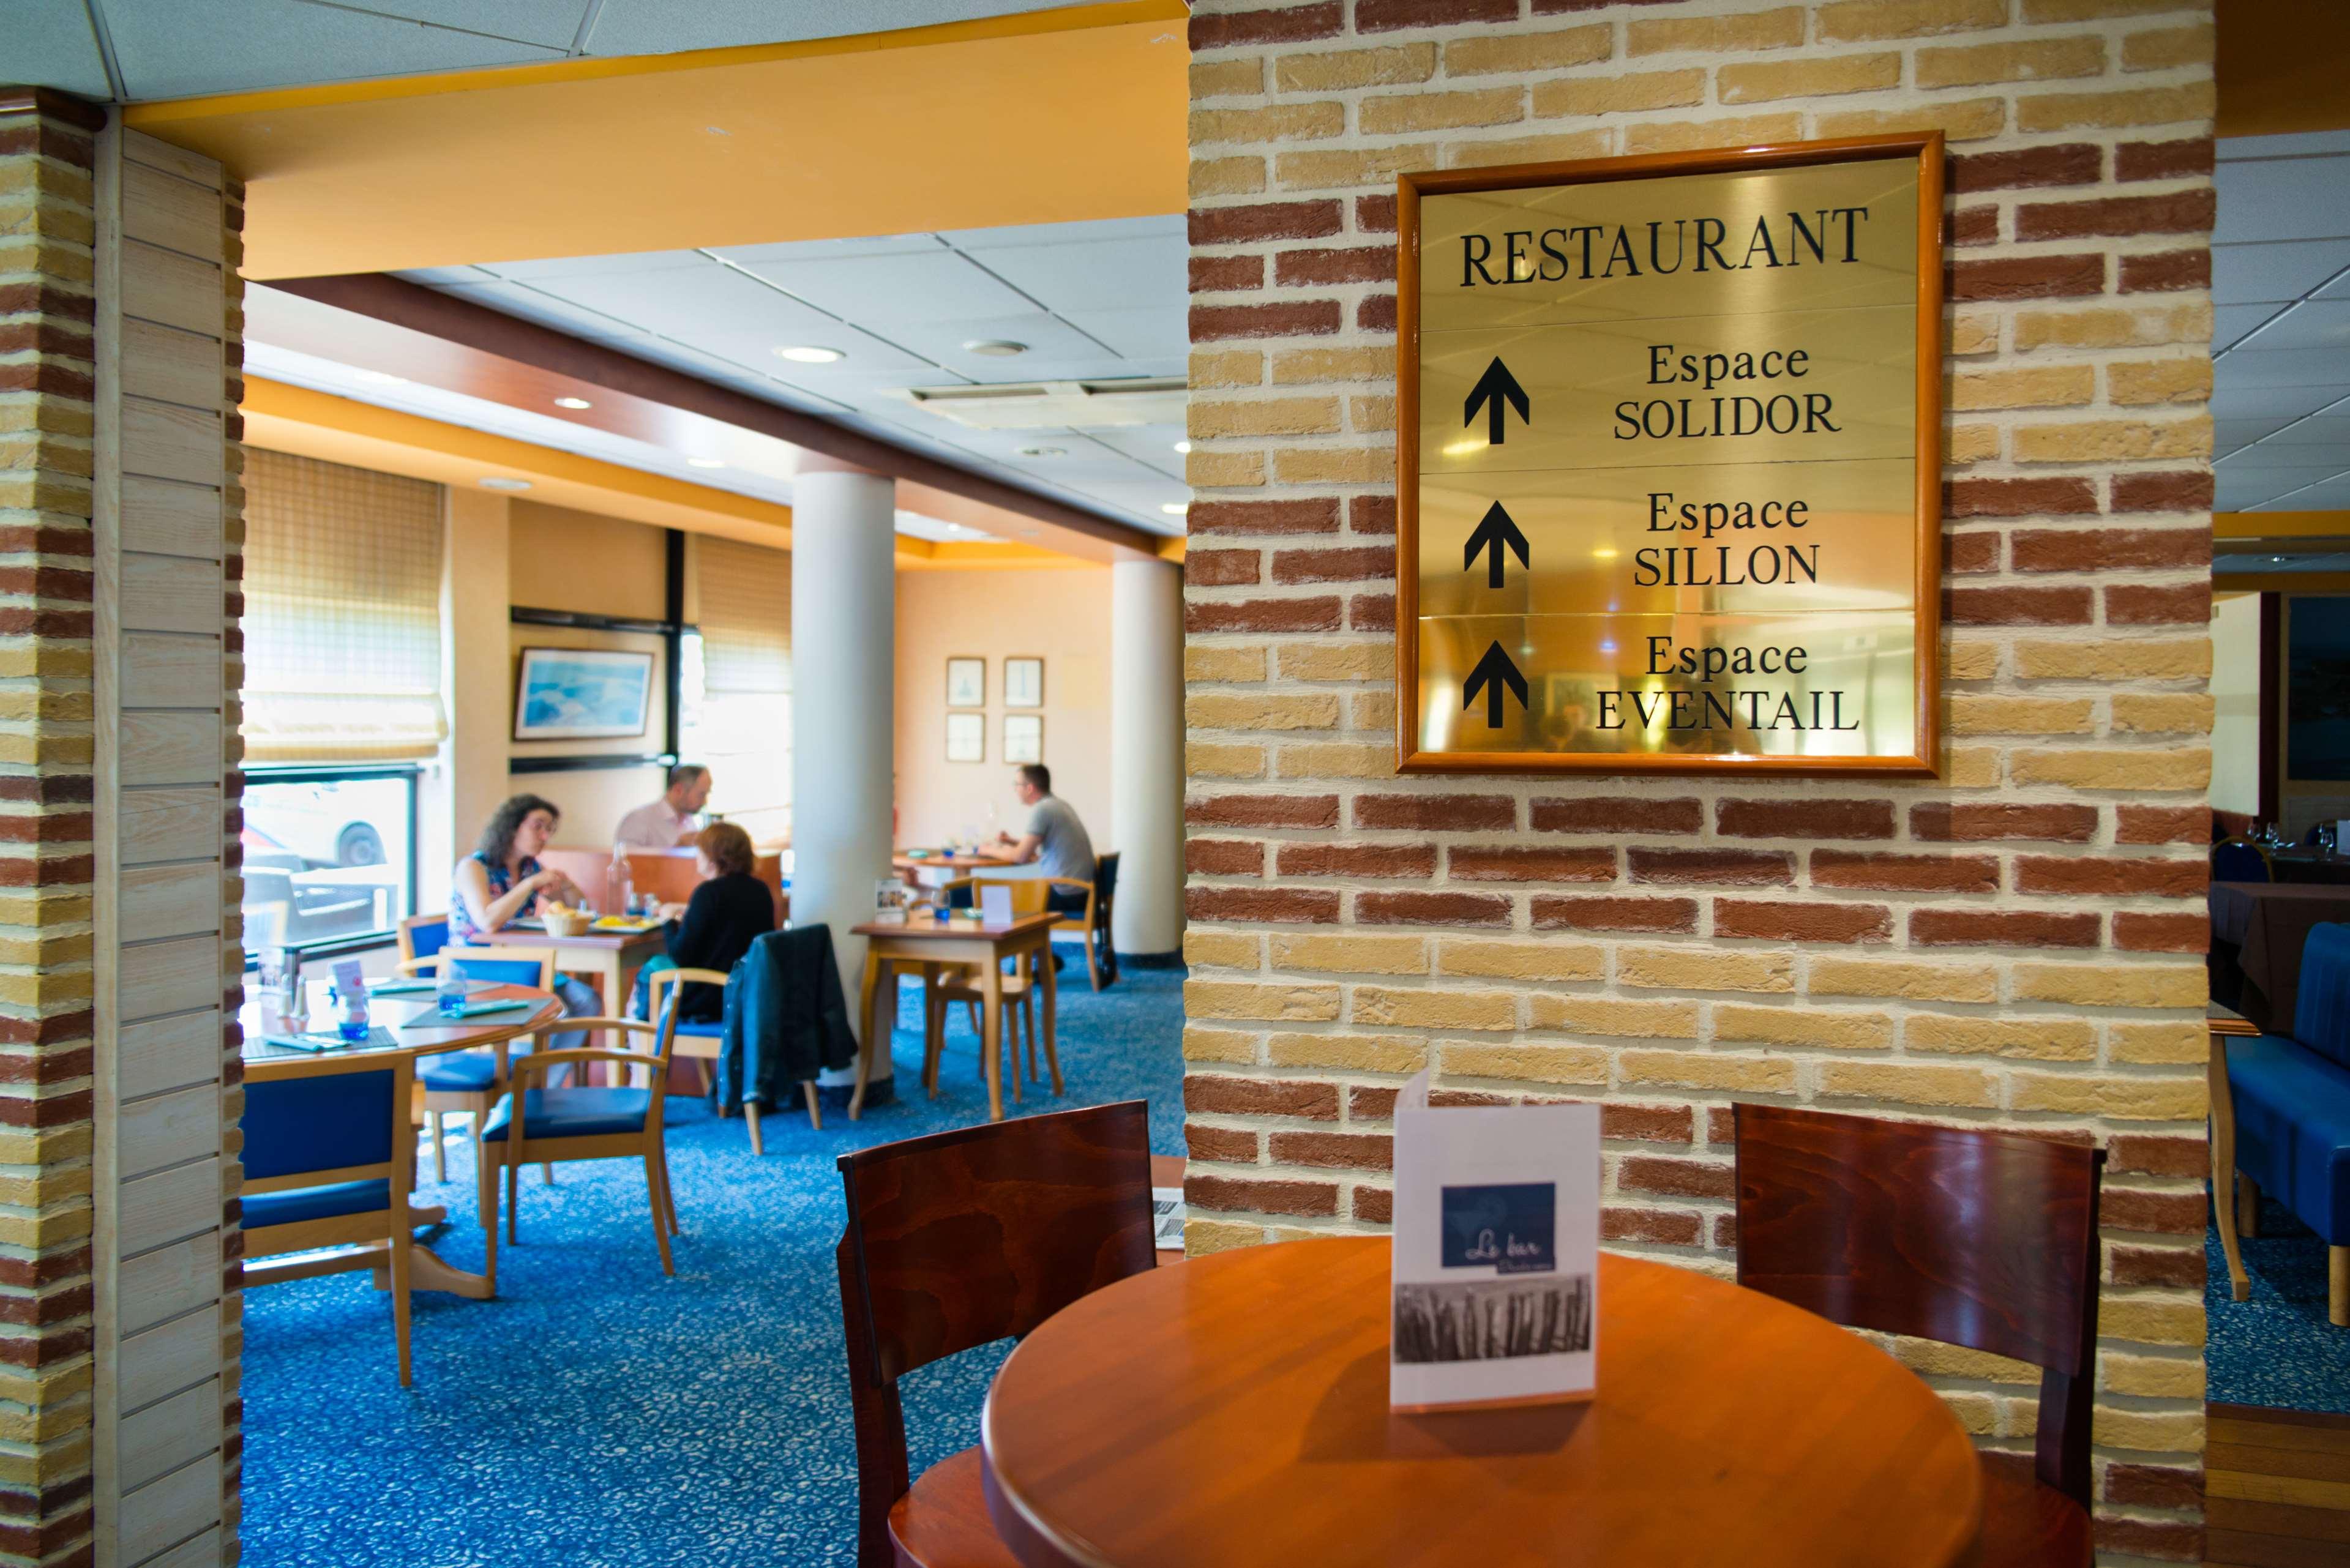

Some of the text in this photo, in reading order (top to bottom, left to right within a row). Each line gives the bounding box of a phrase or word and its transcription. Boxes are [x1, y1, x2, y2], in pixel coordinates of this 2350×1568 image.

[1459, 207, 1869, 287] RESTAURANT
[1646, 344, 1809, 390] Espace
[1614, 393, 1843, 441] SOLIDOR
[1646, 492, 1809, 539] Espace
[1634, 544, 1820, 588] SILLON
[1645, 636, 1808, 682] Espace
[1595, 690, 1859, 731] EVENTAIL
